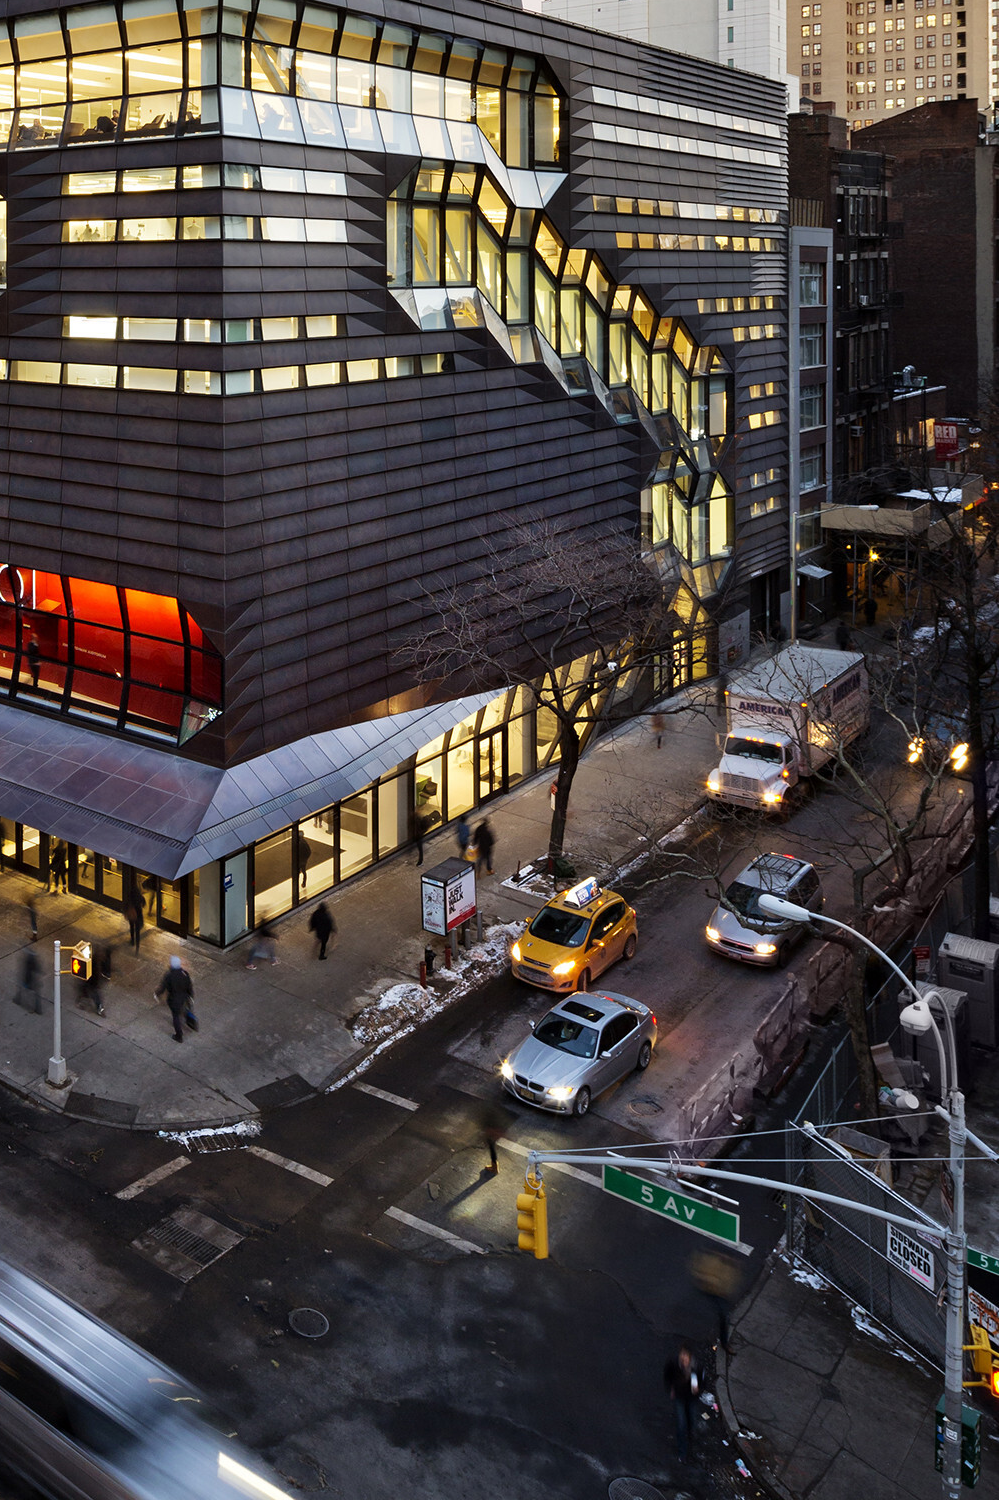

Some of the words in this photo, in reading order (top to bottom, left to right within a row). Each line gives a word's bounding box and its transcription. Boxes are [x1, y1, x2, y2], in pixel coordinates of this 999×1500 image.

[935, 425, 957, 438] RED
[739, 701, 791, 717] AMERICAN
[641, 1185, 654, 1203] 5
[663, 1196, 696, 1220] Av
[890, 1226, 930, 1261] SIDEWALK
[890, 1236, 931, 1277] CLOSED
[980, 1255, 989, 1267] 5
